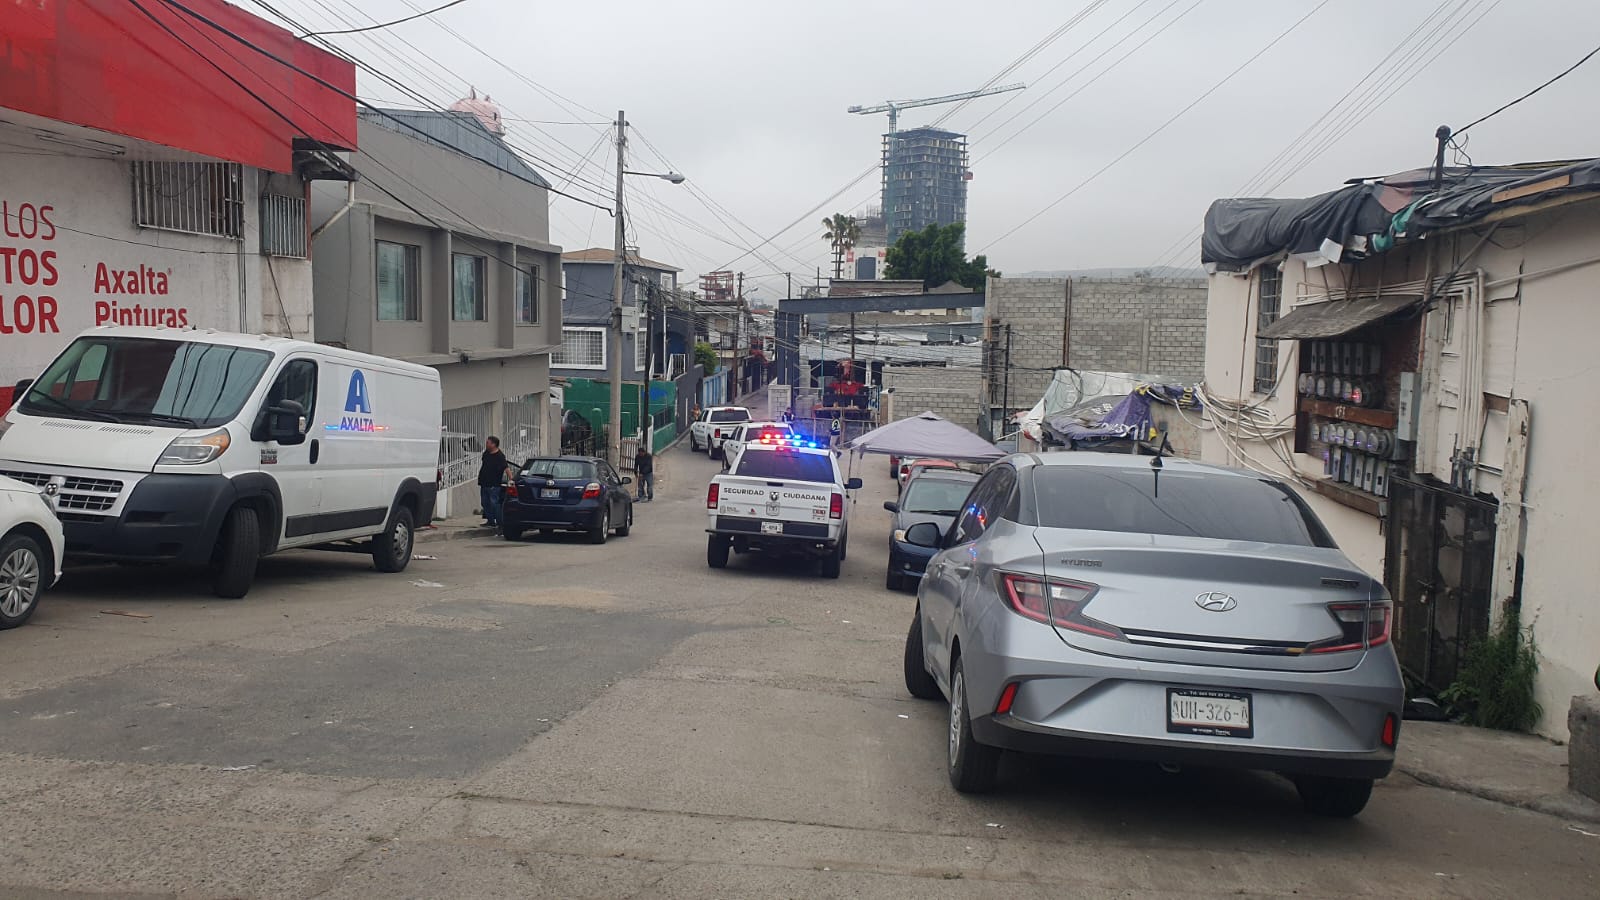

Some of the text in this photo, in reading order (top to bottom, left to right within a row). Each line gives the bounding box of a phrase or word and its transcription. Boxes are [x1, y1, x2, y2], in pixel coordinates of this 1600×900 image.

[3, 200, 57, 240] LOS
[94, 262, 169, 295] Axalta
[95, 301, 188, 328] Pinturas
[340, 416, 375, 433] AXALTA
[723, 487, 826, 502] SEGURIDAD CIUDADANA
[1060, 559, 1104, 568] HYUNDAI
